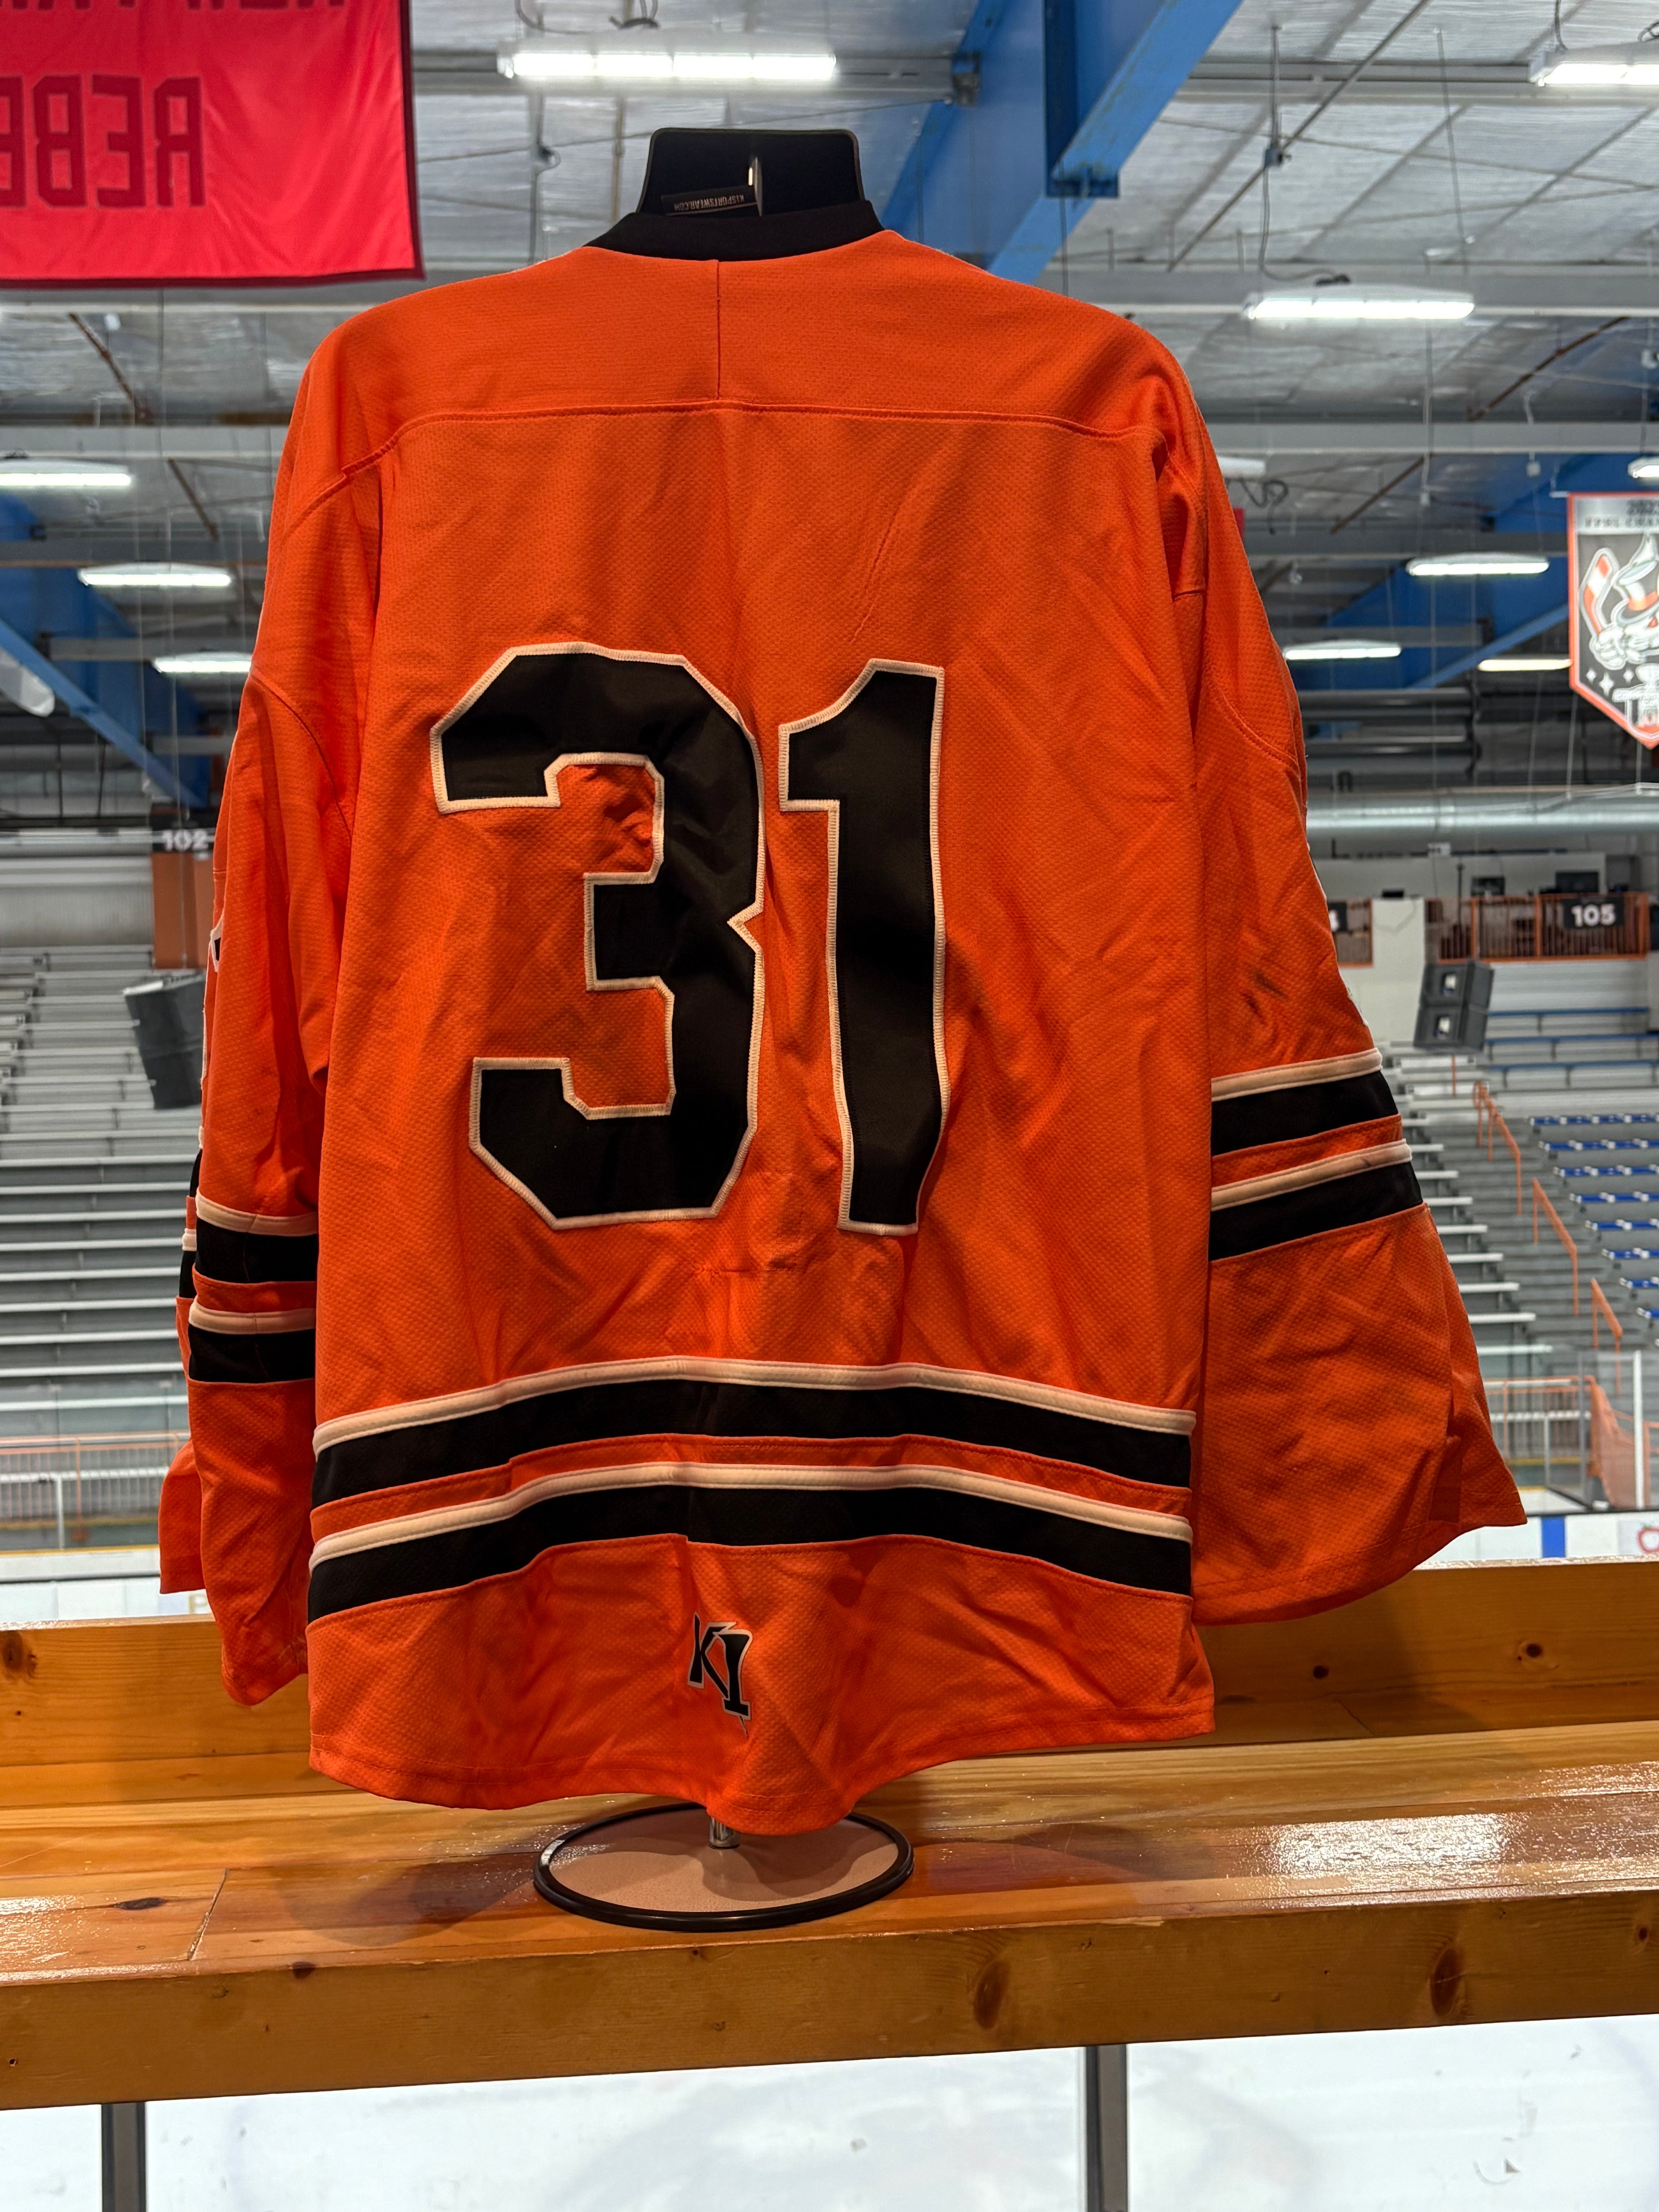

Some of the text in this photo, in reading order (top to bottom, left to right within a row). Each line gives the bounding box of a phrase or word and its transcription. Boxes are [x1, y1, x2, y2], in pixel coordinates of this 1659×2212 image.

[162, 829, 209, 852] 102
[1571, 903, 1615, 927] 105
[431, 642, 950, 1236] 31
